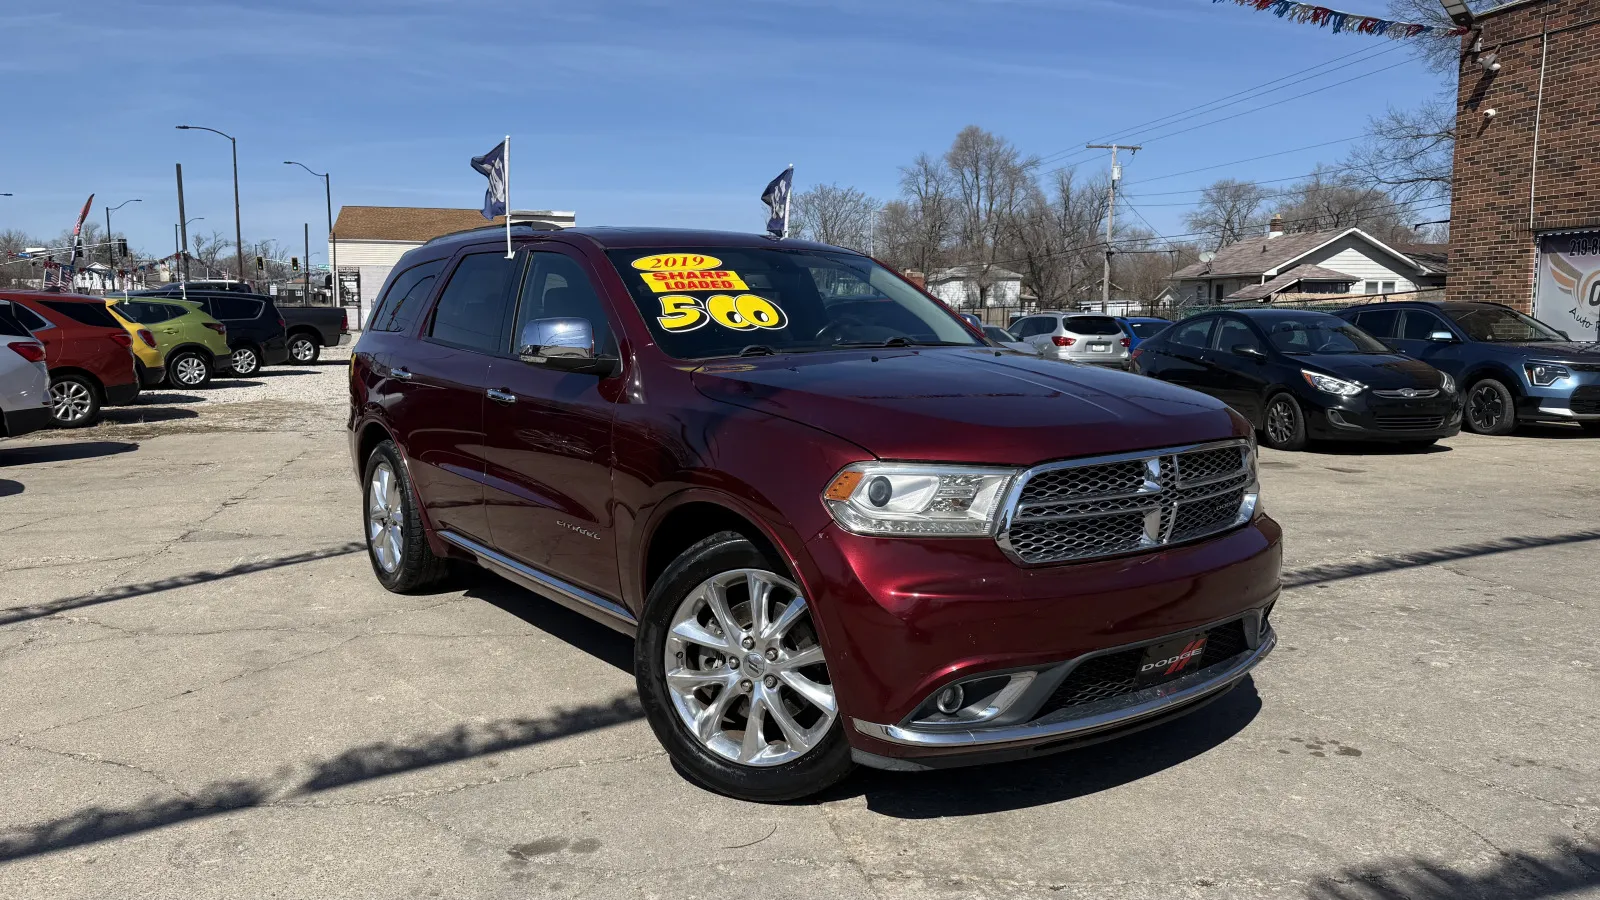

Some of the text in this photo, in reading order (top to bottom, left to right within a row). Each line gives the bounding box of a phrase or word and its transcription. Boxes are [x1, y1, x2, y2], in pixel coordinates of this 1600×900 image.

[1569, 237, 1600, 257] 219-8
[650, 255, 705, 269] 2019
[652, 271, 730, 281] SHARP
[665, 280, 735, 290] LOADED
[657, 294, 788, 333] 500
[1569, 307, 1593, 329] Auto
[1141, 647, 1203, 672] DODGE
